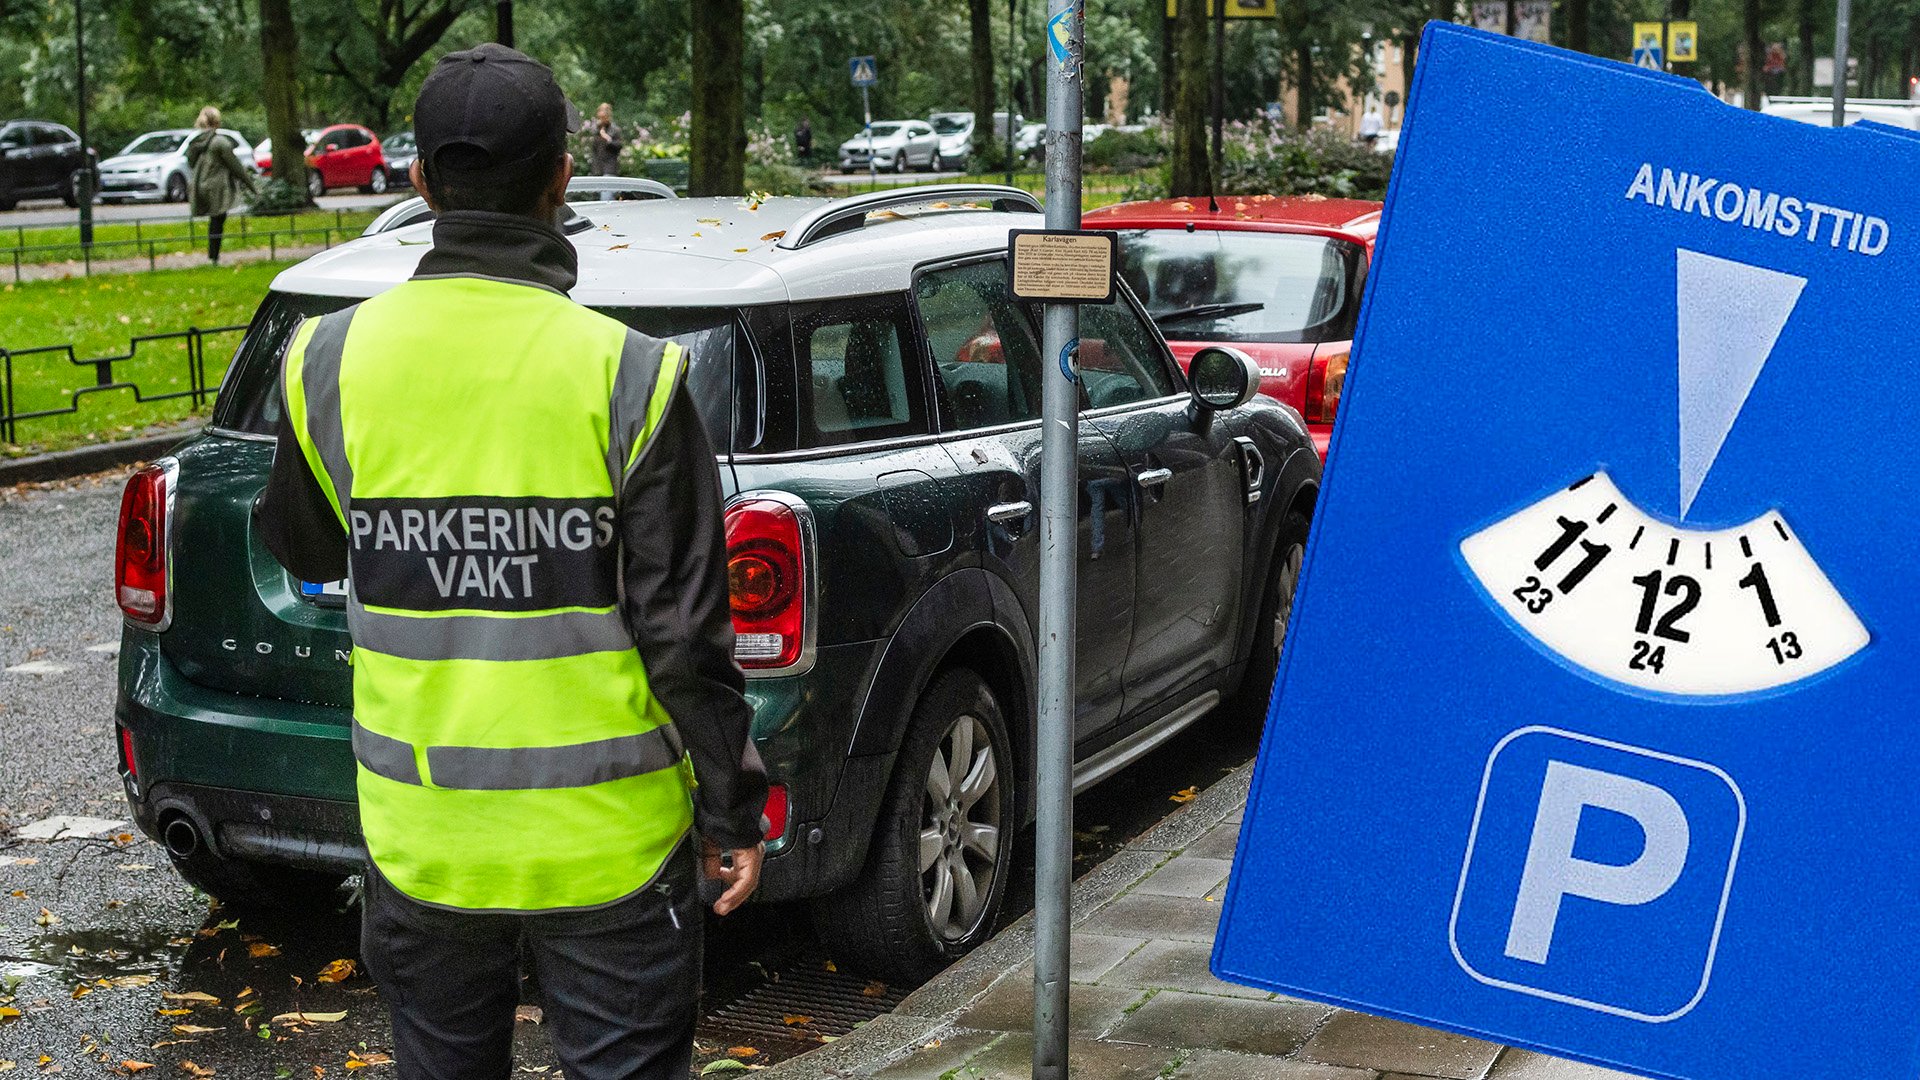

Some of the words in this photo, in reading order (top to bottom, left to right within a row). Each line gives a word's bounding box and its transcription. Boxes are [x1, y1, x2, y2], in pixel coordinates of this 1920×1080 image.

[1625, 163, 1889, 256] ANKOMSTTID
[350, 507, 615, 551] PARKERINGS
[427, 555, 539, 598] VAKT
[1513, 576, 1554, 614] 23
[1629, 640, 1666, 674] 24
[1765, 631, 1803, 665] 13
[1534, 516, 1611, 594] 11
[1632, 569, 1702, 643] 12
[1738, 562, 1782, 627] 1
[1503, 759, 1690, 965] P
